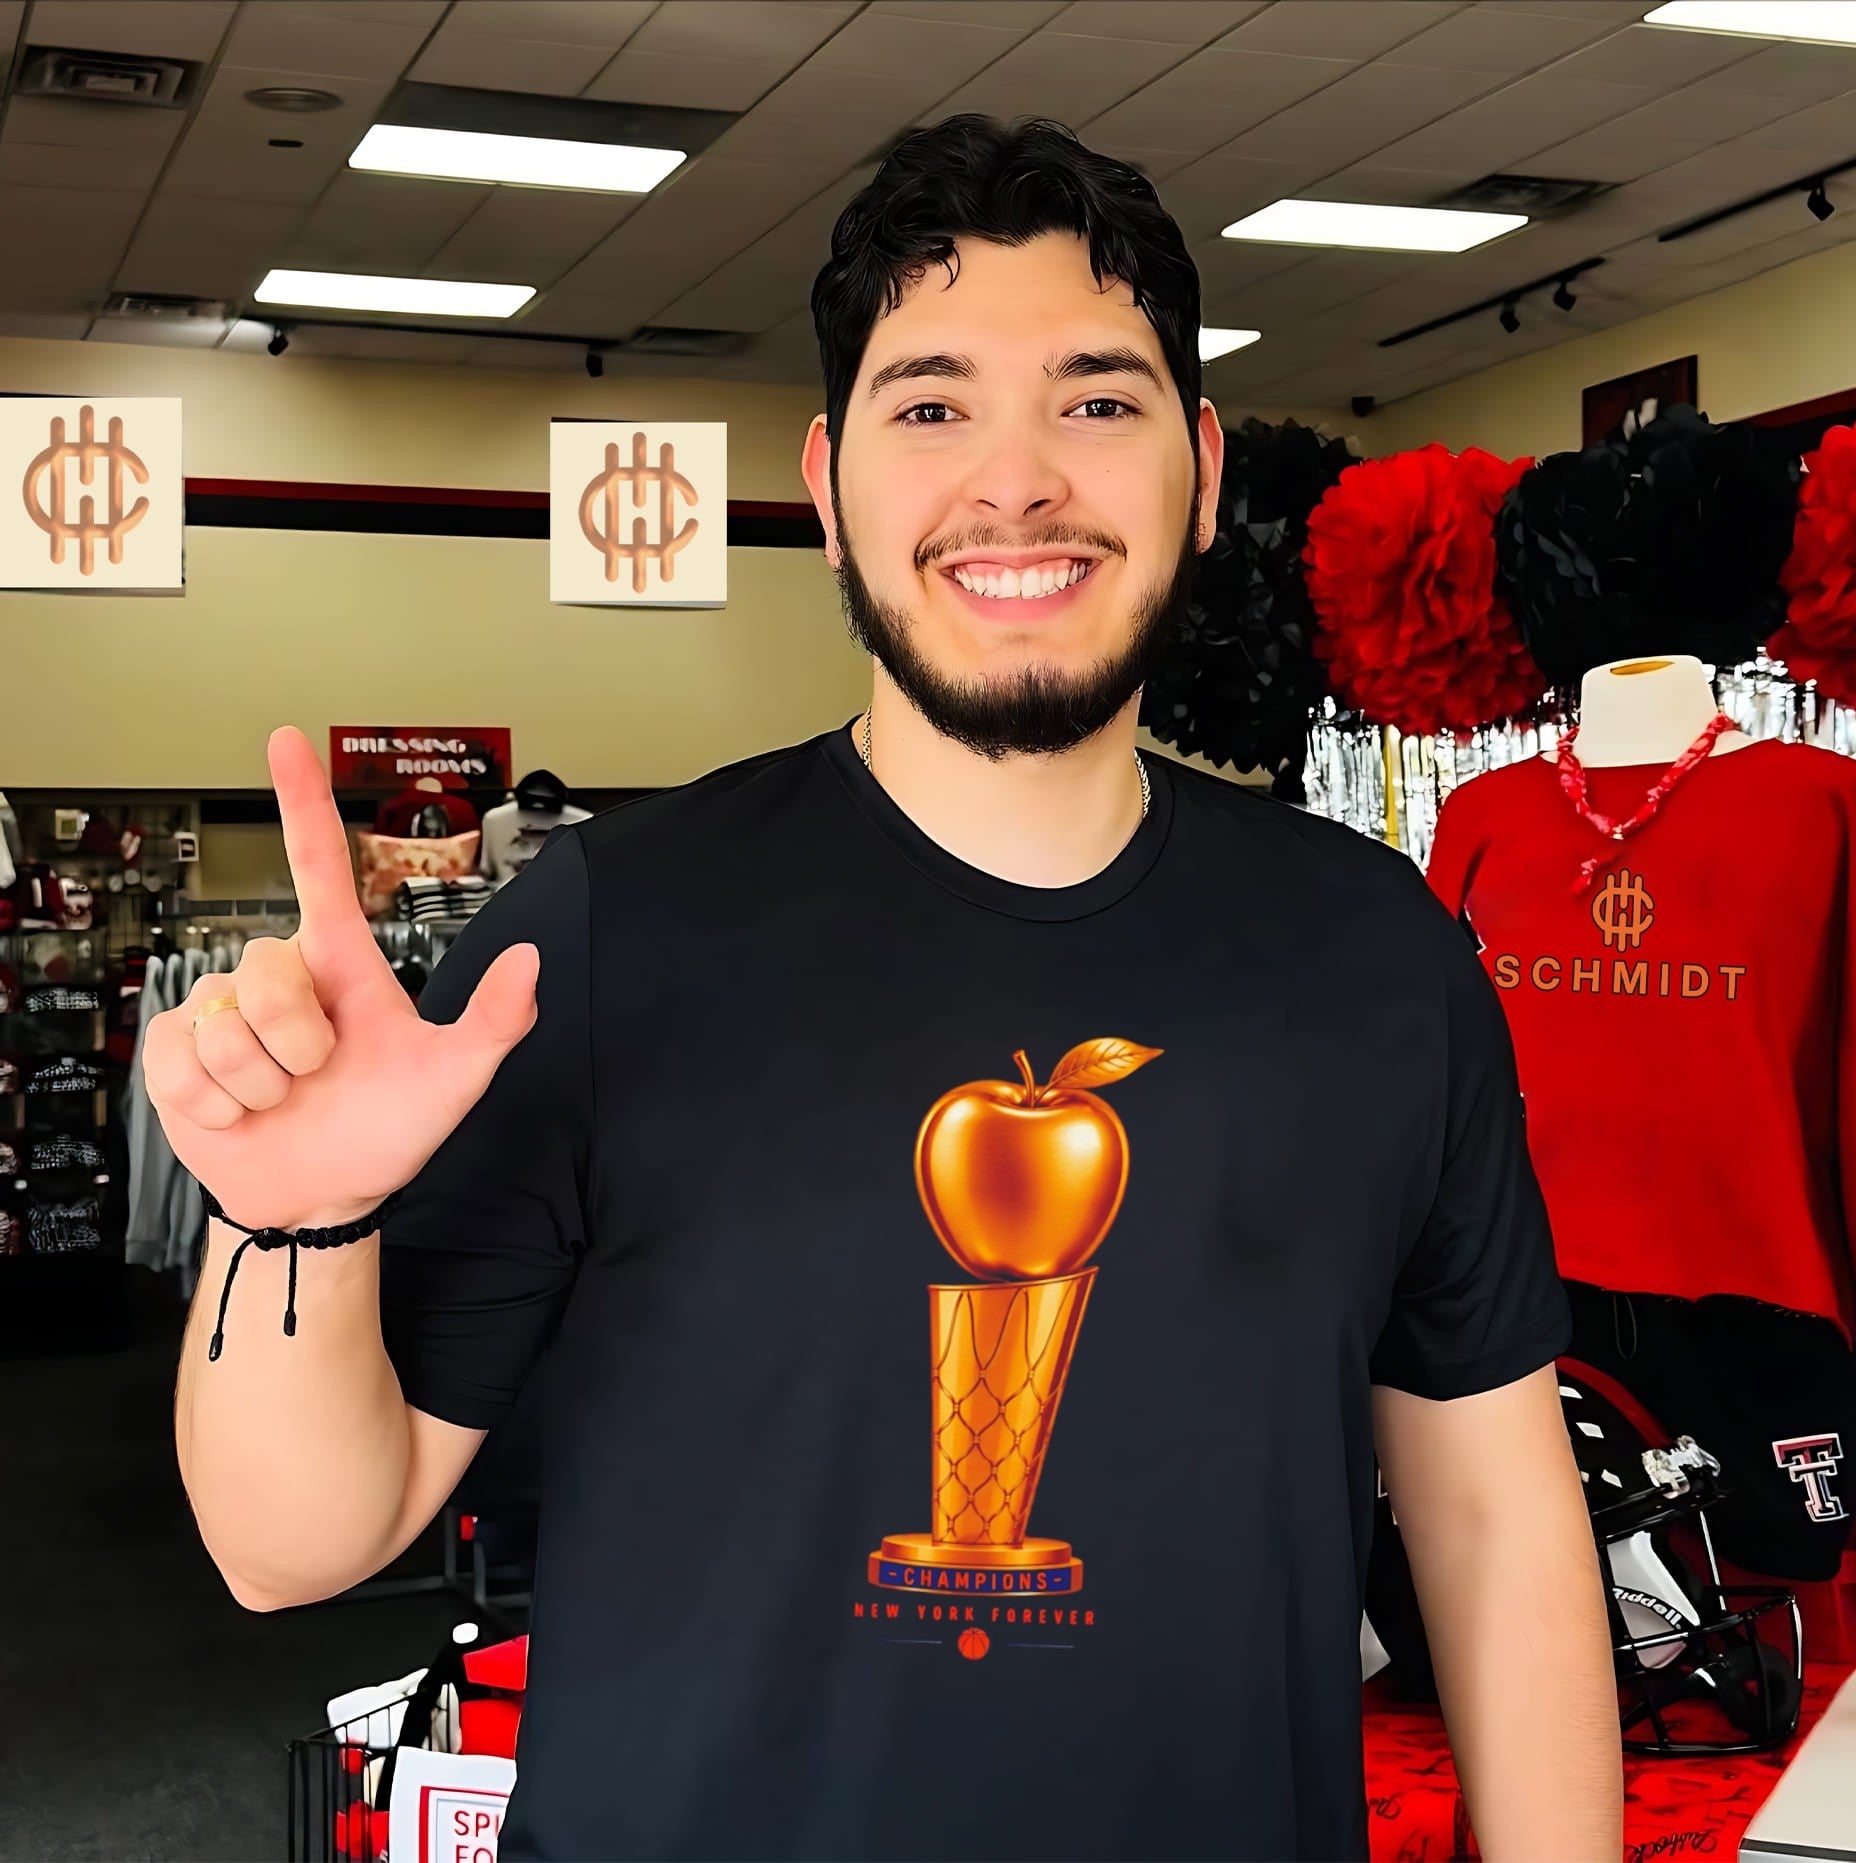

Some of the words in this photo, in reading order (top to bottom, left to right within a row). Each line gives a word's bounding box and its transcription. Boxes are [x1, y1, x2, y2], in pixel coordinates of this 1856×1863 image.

[1494, 953, 1747, 1000] SCHMIDT
[854, 1602, 899, 1619] NEW
[917, 1604, 974, 1622] YORK
[991, 1607, 1095, 1626] FOREVER
